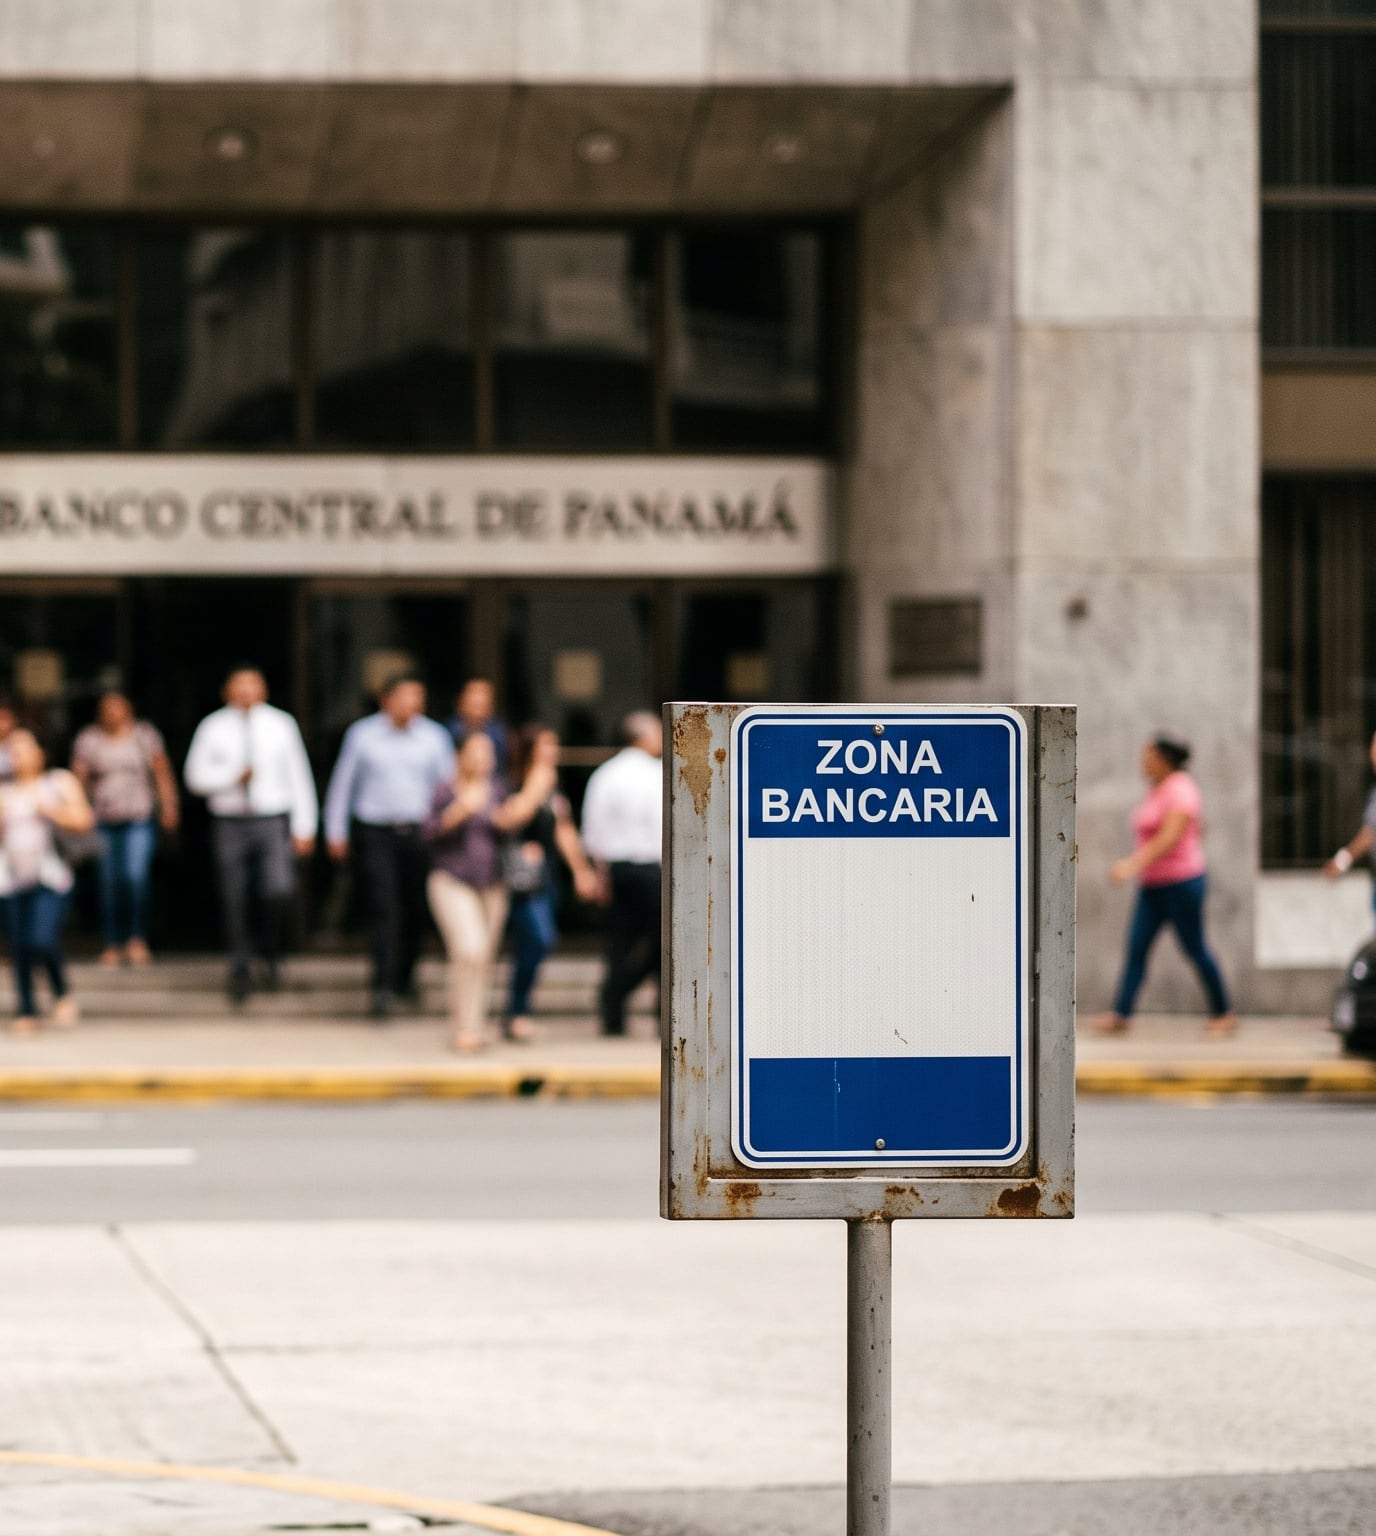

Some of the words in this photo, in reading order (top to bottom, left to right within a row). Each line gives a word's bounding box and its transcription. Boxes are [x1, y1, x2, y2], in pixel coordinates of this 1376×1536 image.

[200, 489, 453, 540] CENTRAL
[476, 489, 544, 540] DE
[562, 480, 799, 540] PANAMÁ
[815, 739, 943, 775] ZONA
[761, 787, 998, 823] BANCARIA
